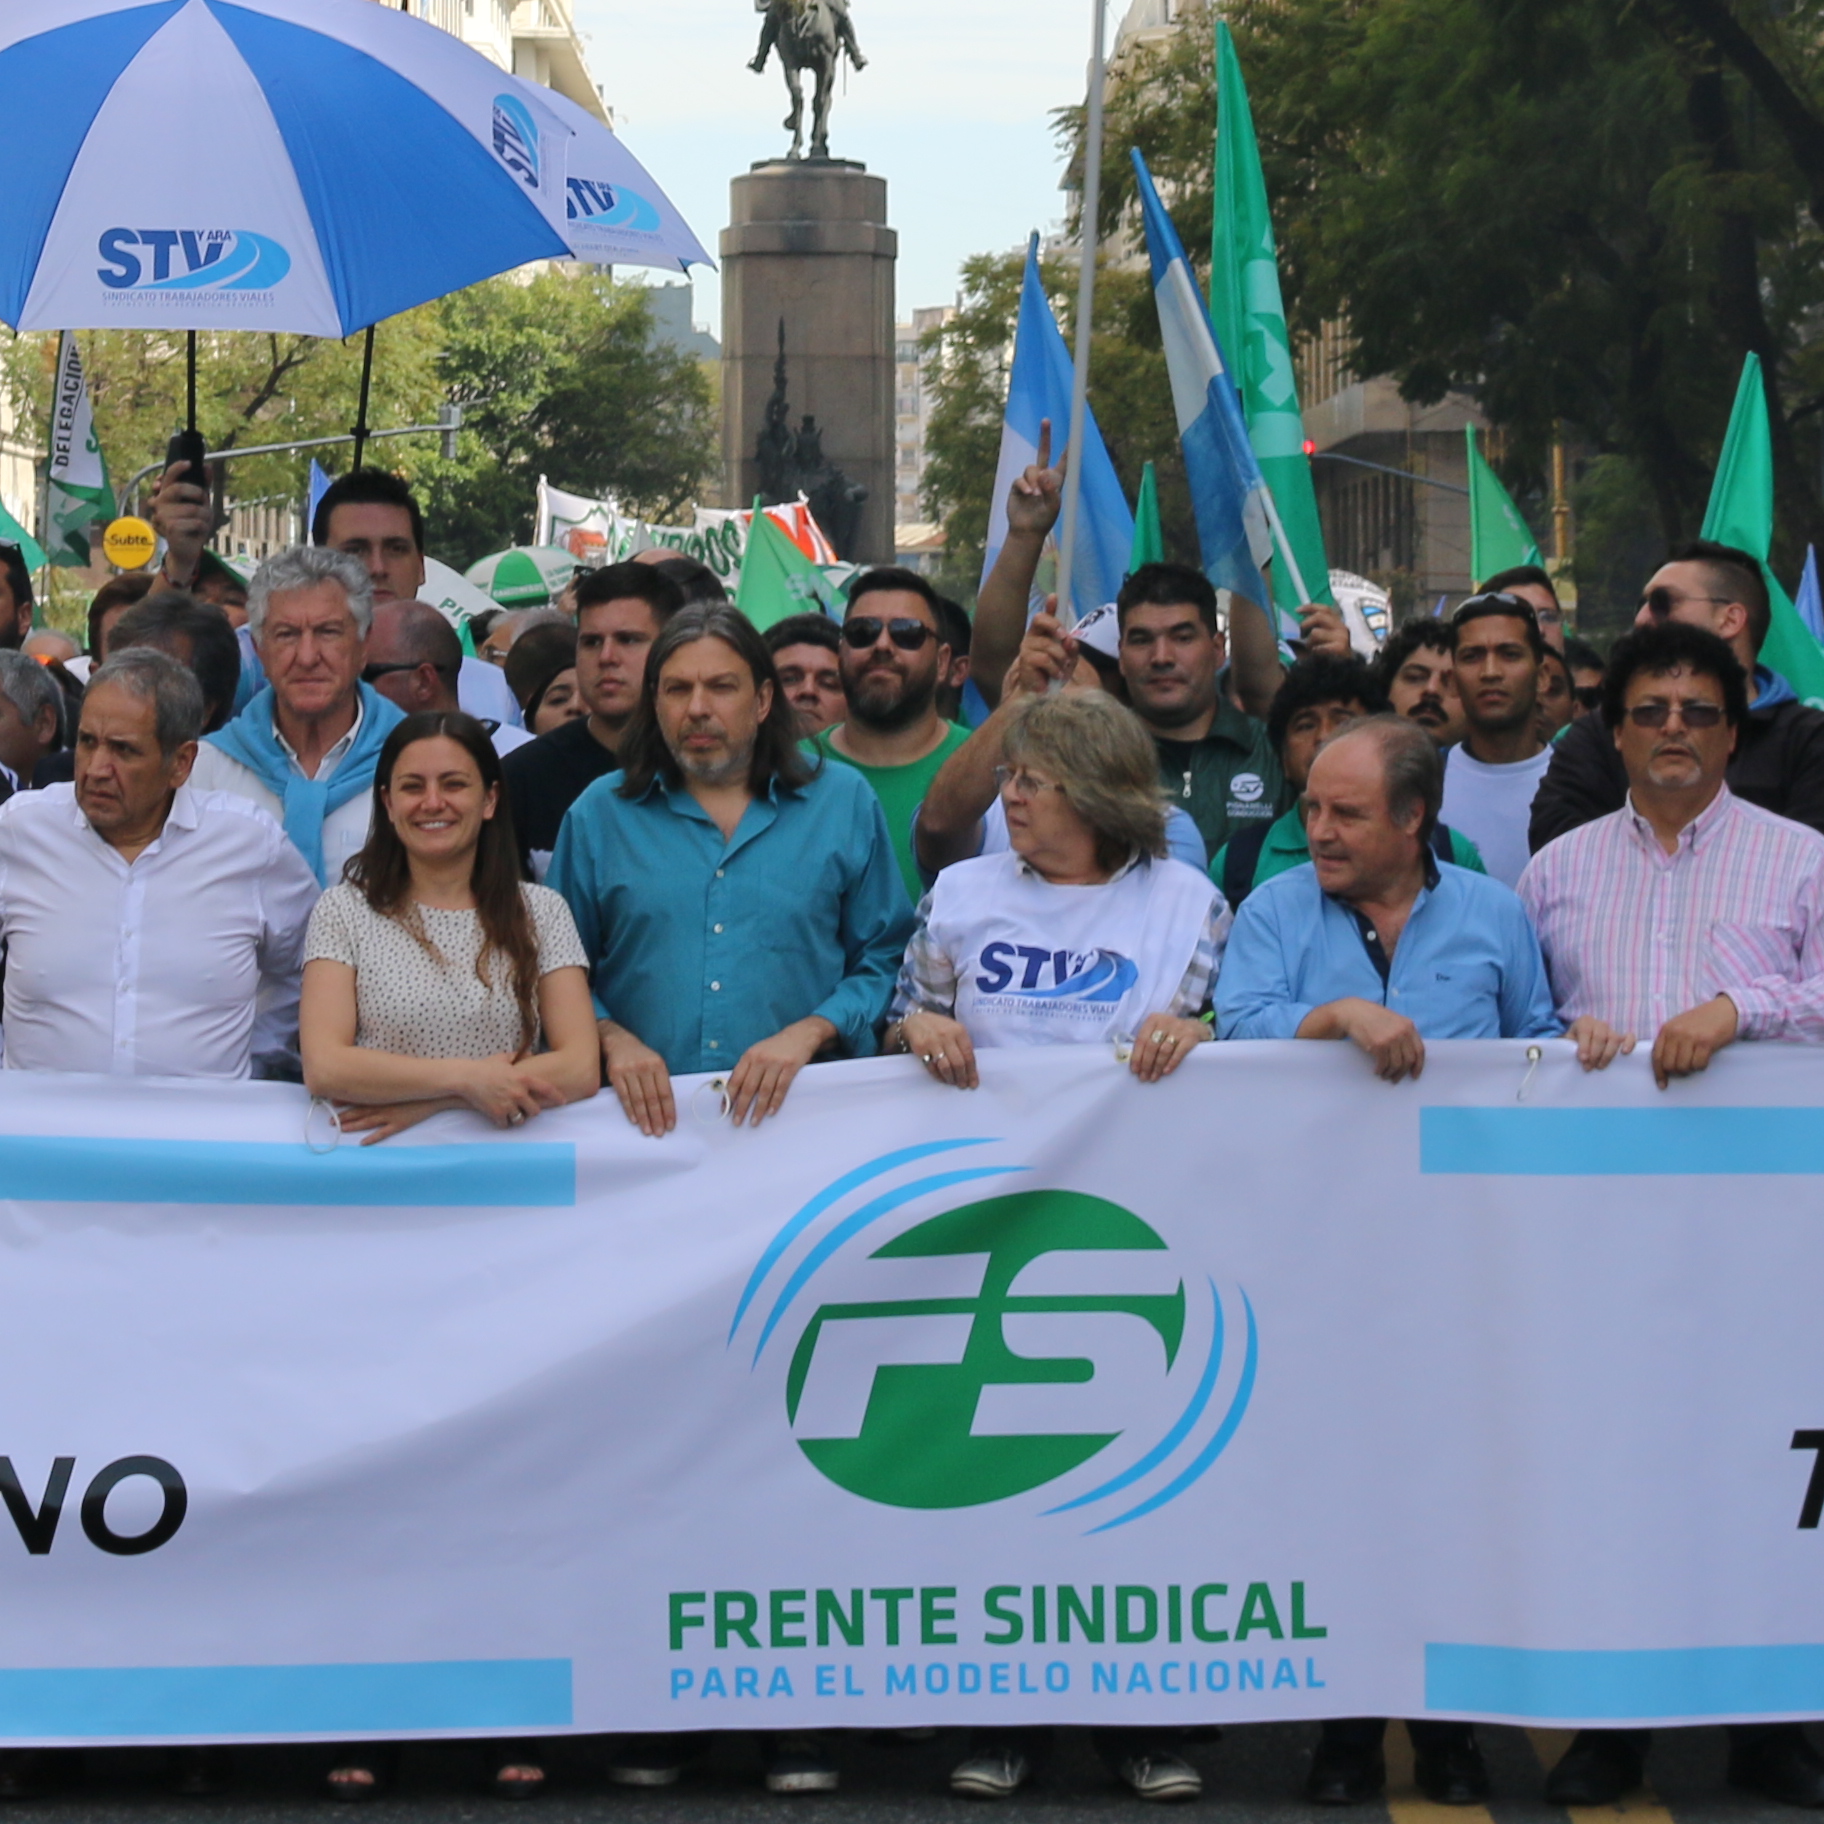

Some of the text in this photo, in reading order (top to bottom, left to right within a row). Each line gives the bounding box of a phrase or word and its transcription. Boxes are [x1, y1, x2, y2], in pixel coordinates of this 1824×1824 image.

[97, 227, 224, 289] STV
[207, 231, 232, 242] ARA
[102, 291, 274, 302] SINDICATO TRABAJADORES VIALES
[110, 533, 148, 546] Subte
[1017, 999, 1089, 1014] TRABAJADORES
[668, 1581, 1328, 1651] FRENTE SINDICAL
[670, 1656, 1327, 1701] PARA EL MODELO NACIONAL
